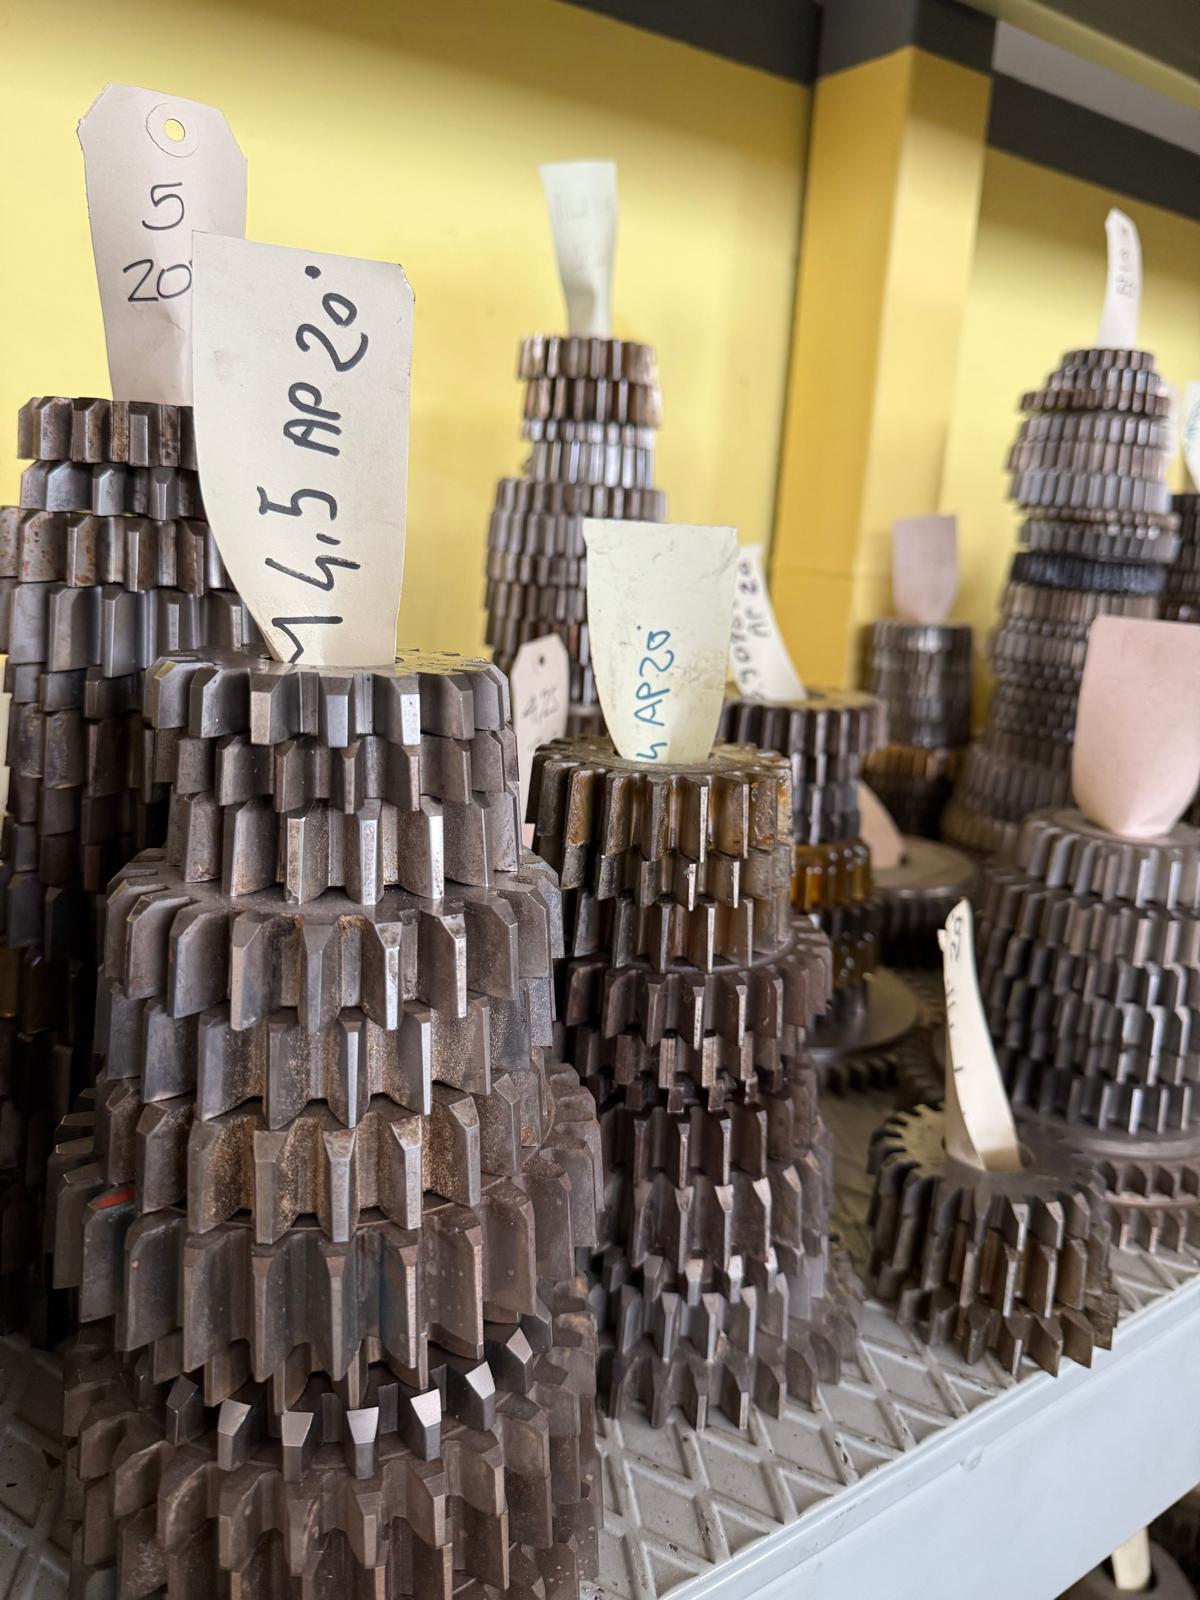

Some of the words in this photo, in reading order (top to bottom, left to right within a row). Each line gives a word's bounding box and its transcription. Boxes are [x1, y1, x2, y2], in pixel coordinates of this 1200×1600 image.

[142, 182, 185, 231] 5
[122, 258, 192, 302] 20
[283, 381, 342, 456] AP
